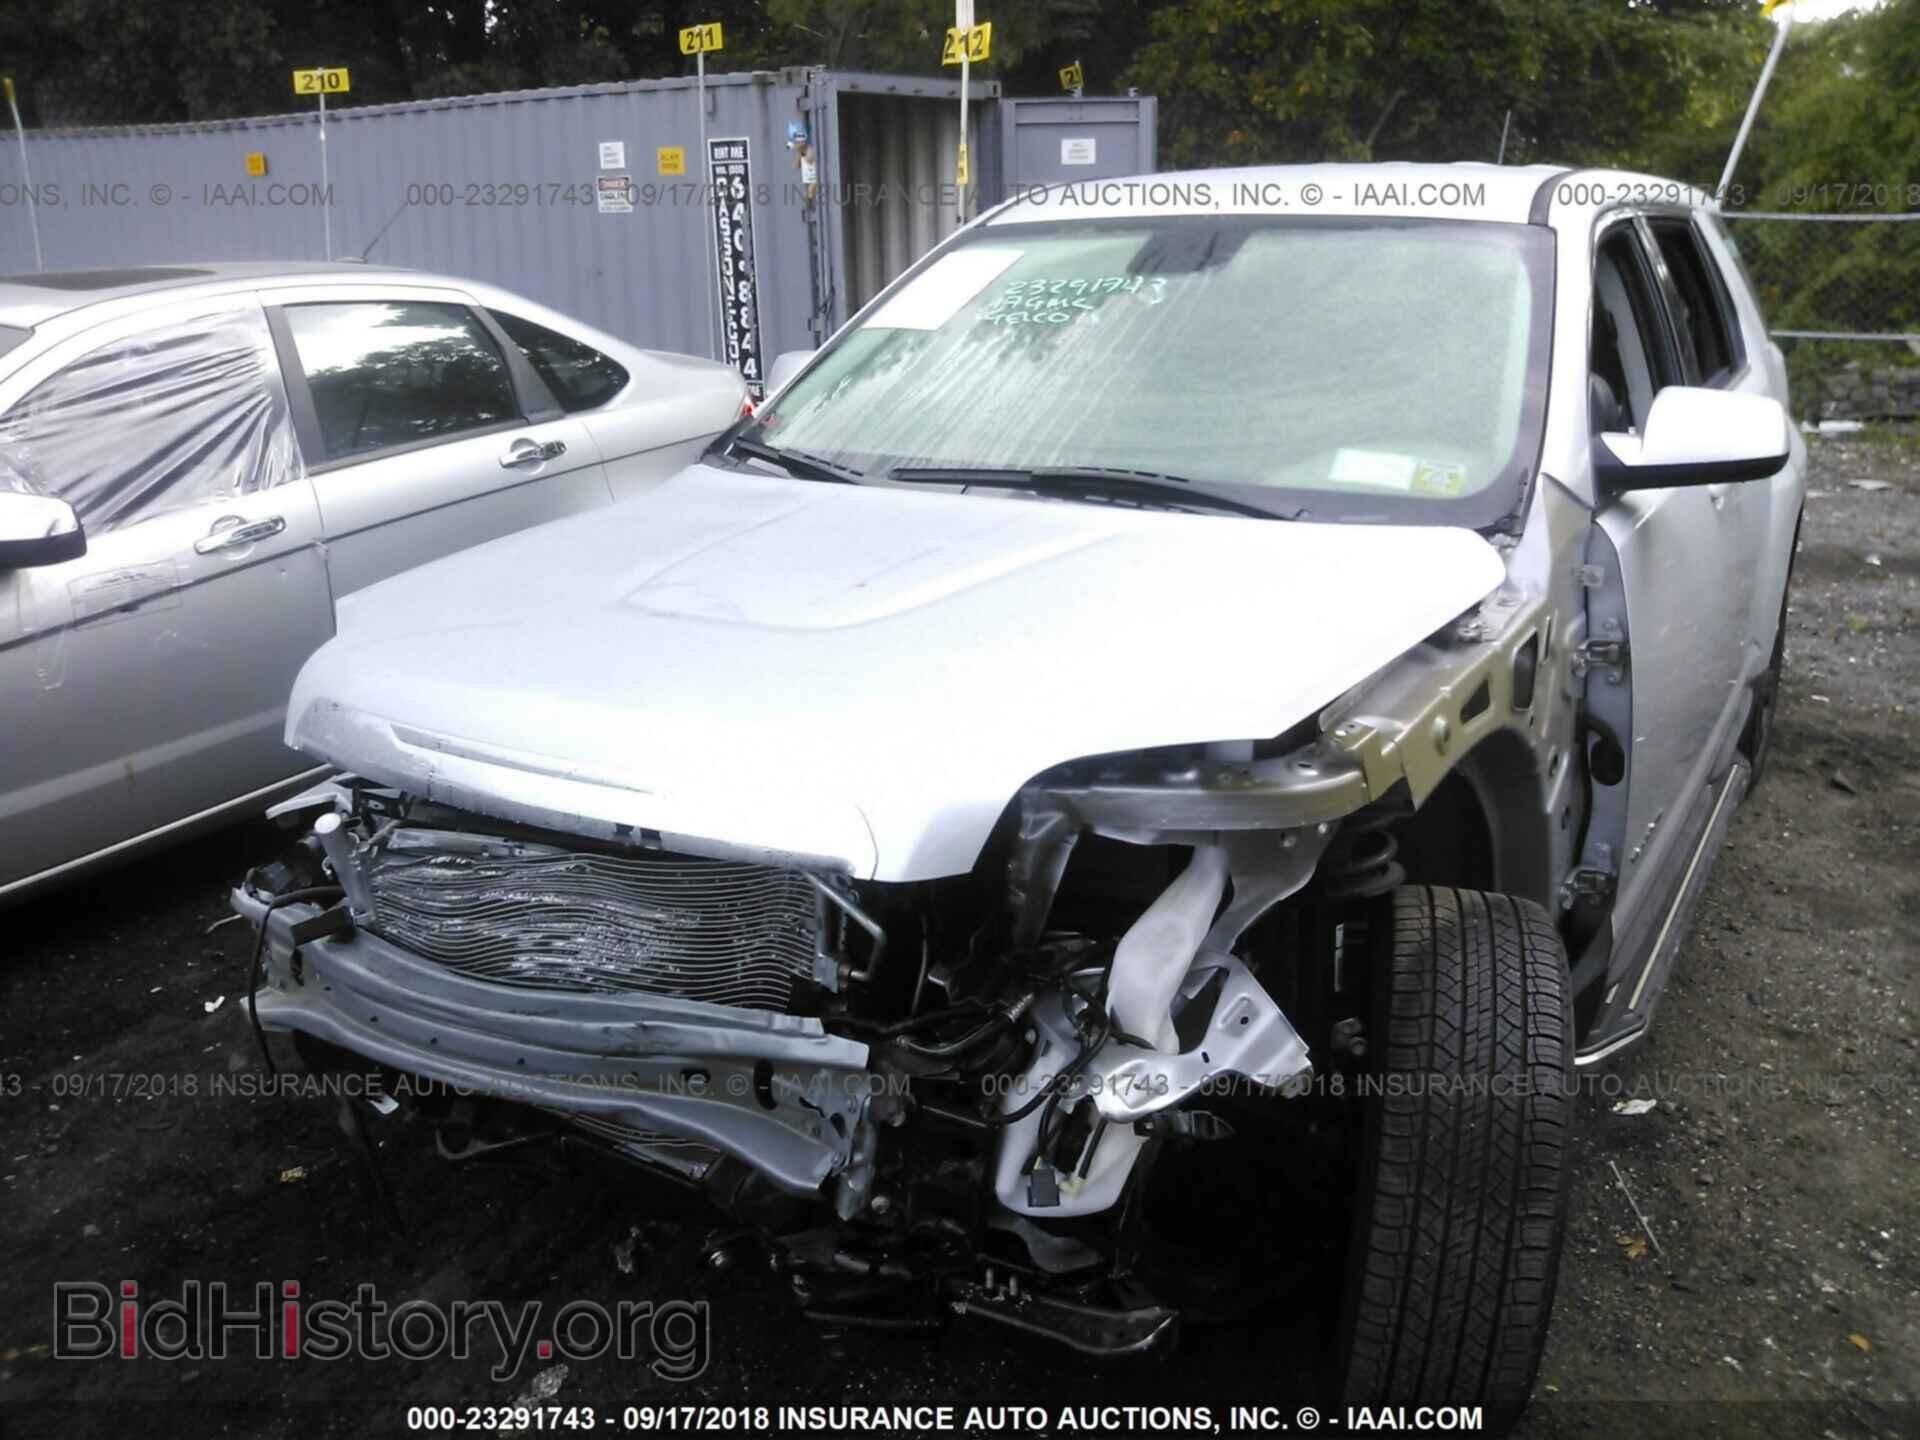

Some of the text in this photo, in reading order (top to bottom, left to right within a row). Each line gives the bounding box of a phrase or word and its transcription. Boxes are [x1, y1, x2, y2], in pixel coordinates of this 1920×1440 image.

[686, 27, 714, 50] 211
[944, 29, 984, 59] 212
[302, 72, 340, 90] 210
